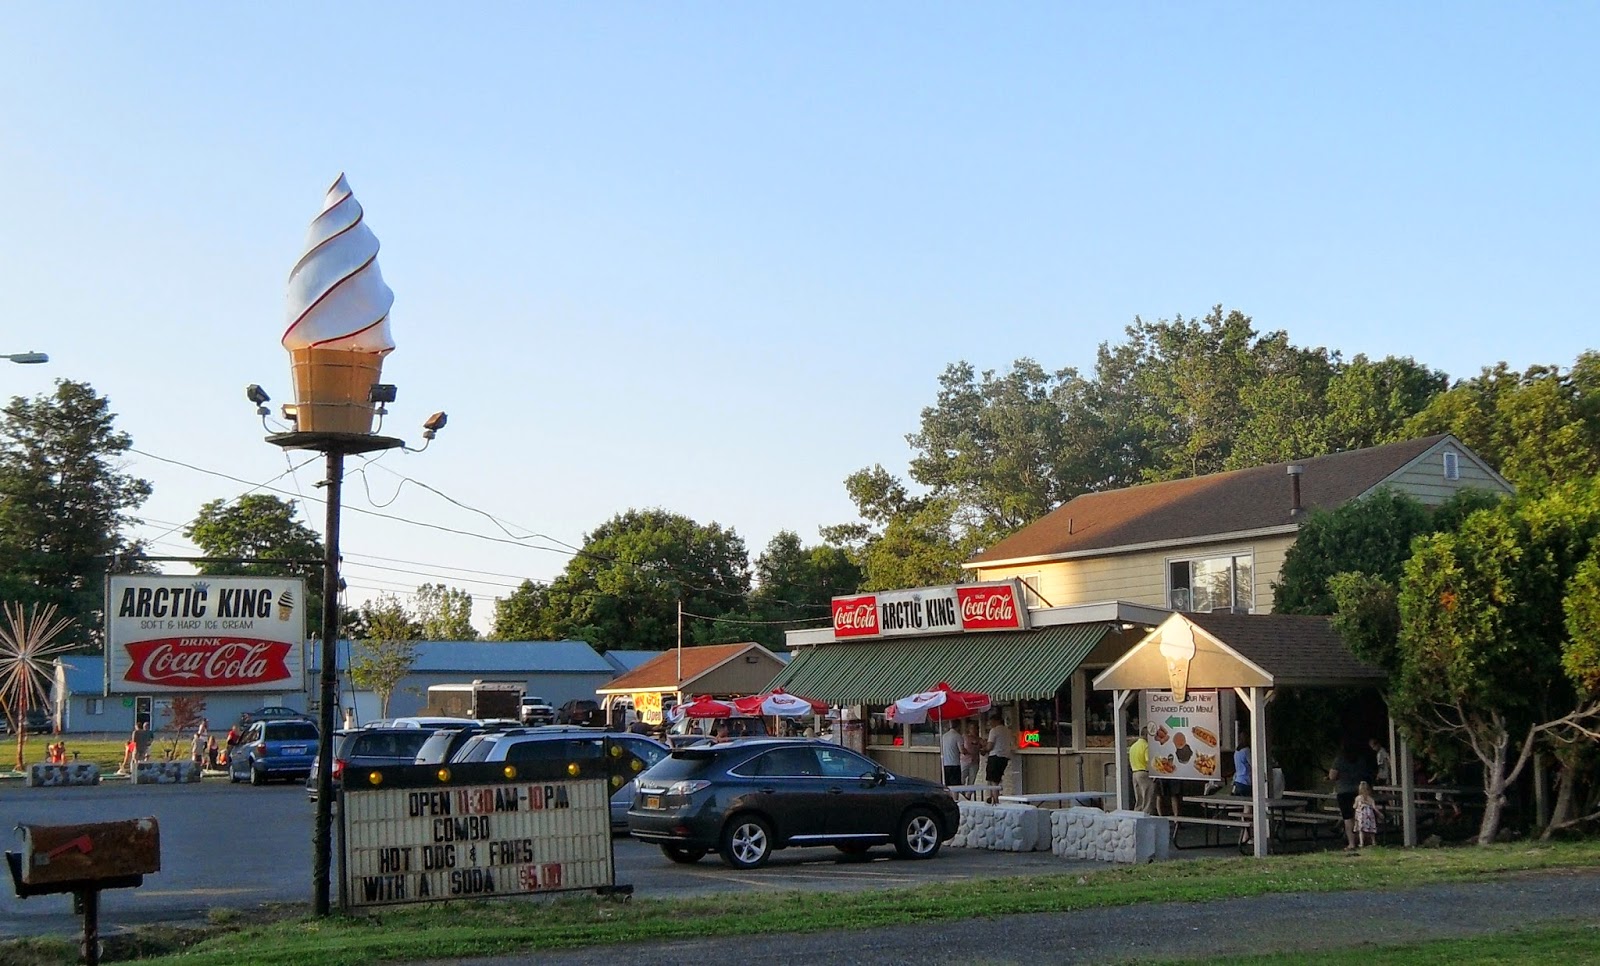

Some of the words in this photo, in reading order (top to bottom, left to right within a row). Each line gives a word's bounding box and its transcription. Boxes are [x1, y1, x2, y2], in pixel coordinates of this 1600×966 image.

[119, 587, 208, 618] ARCTIC
[217, 588, 272, 618] KING
[882, 602, 923, 630] ARCTIC
[925, 597, 956, 627] KING
[140, 619, 164, 630] SOFT
[167, 620, 174, 629] &
[177, 619, 201, 630] HARD
[204, 620, 218, 630] ICE
[222, 620, 254, 630] CREAM
[179, 638, 221, 647] DRINK
[409, 791, 451, 817] OPEN
[433, 815, 490, 842] COMBO
[380, 847, 412, 873] HOT
[423, 844, 456, 870] DOG
[489, 839, 533, 866] FRIES
[363, 876, 405, 901] WITH
[419, 873, 430, 897] A
[451, 868, 495, 895] SODA
